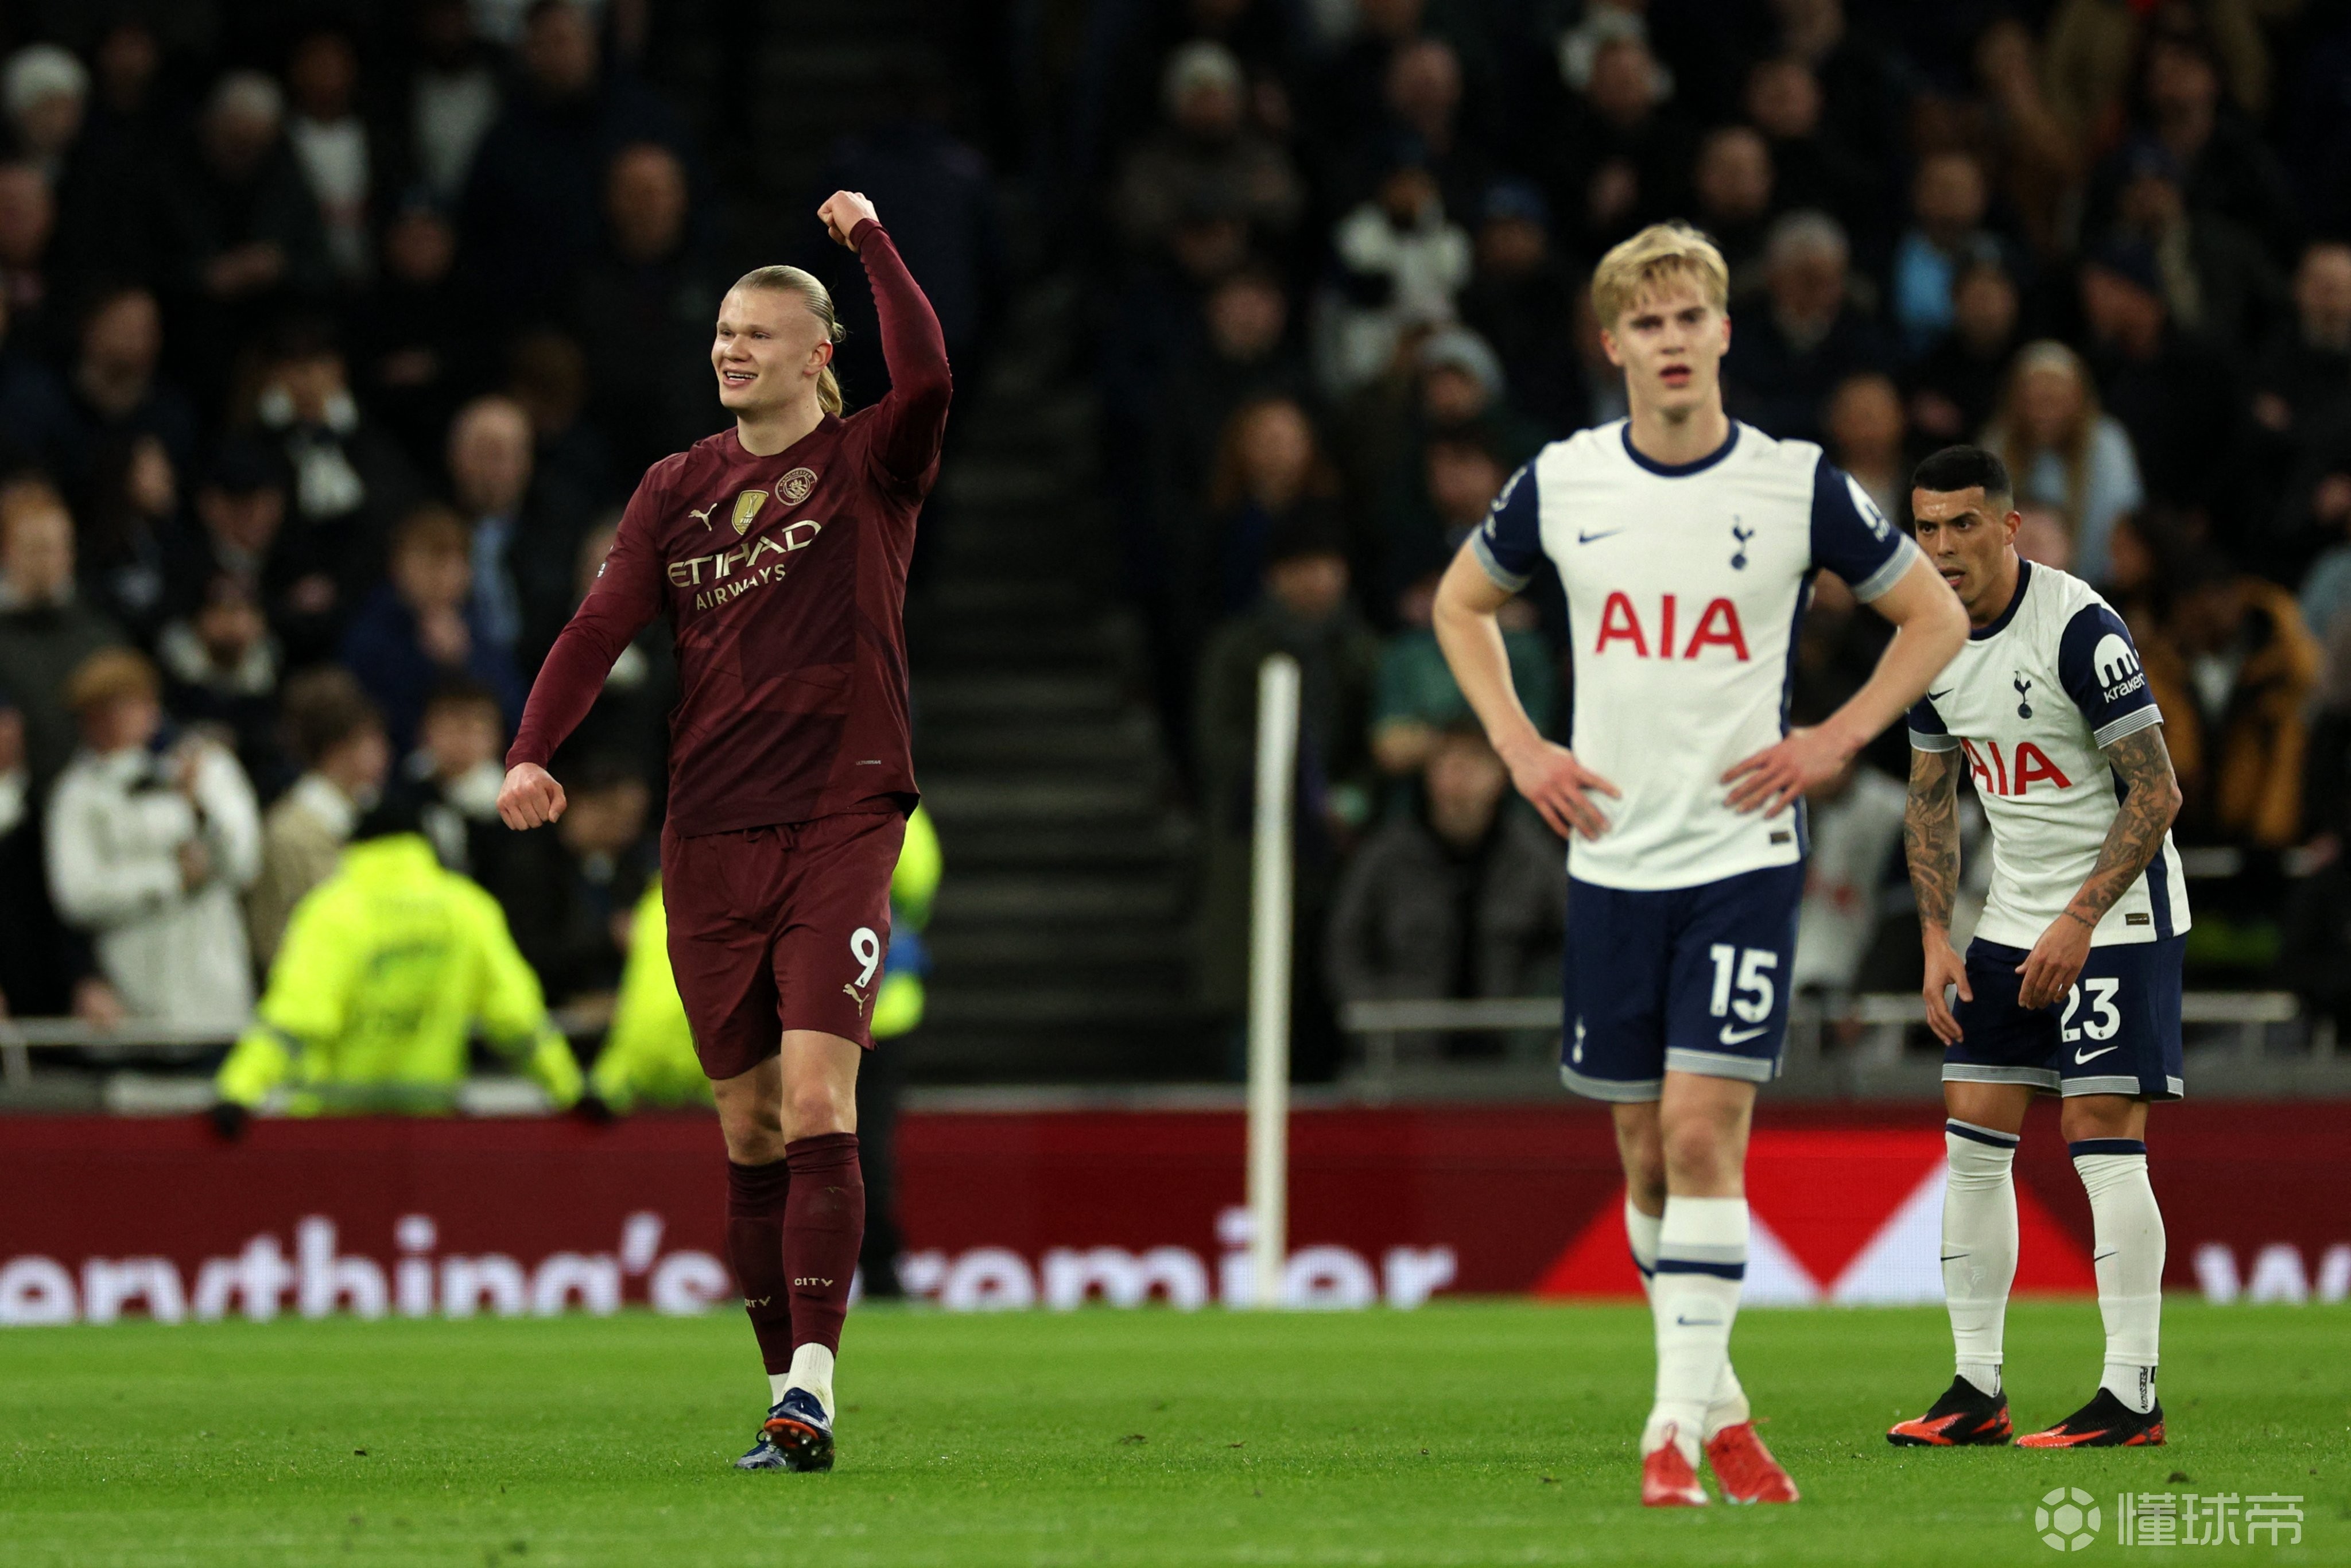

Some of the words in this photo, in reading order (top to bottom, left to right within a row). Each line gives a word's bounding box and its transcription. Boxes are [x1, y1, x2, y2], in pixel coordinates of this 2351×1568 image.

[668, 520, 822, 587] ETIHAD
[696, 564, 786, 610] AIRWAYS
[1595, 591, 1749, 662] AIA
[1960, 737, 2073, 796] AIA
[851, 927, 879, 988] 9
[1710, 943, 1778, 1023] 15
[2061, 977, 2121, 1043] 23
[794, 1277, 833, 1287] CITY
